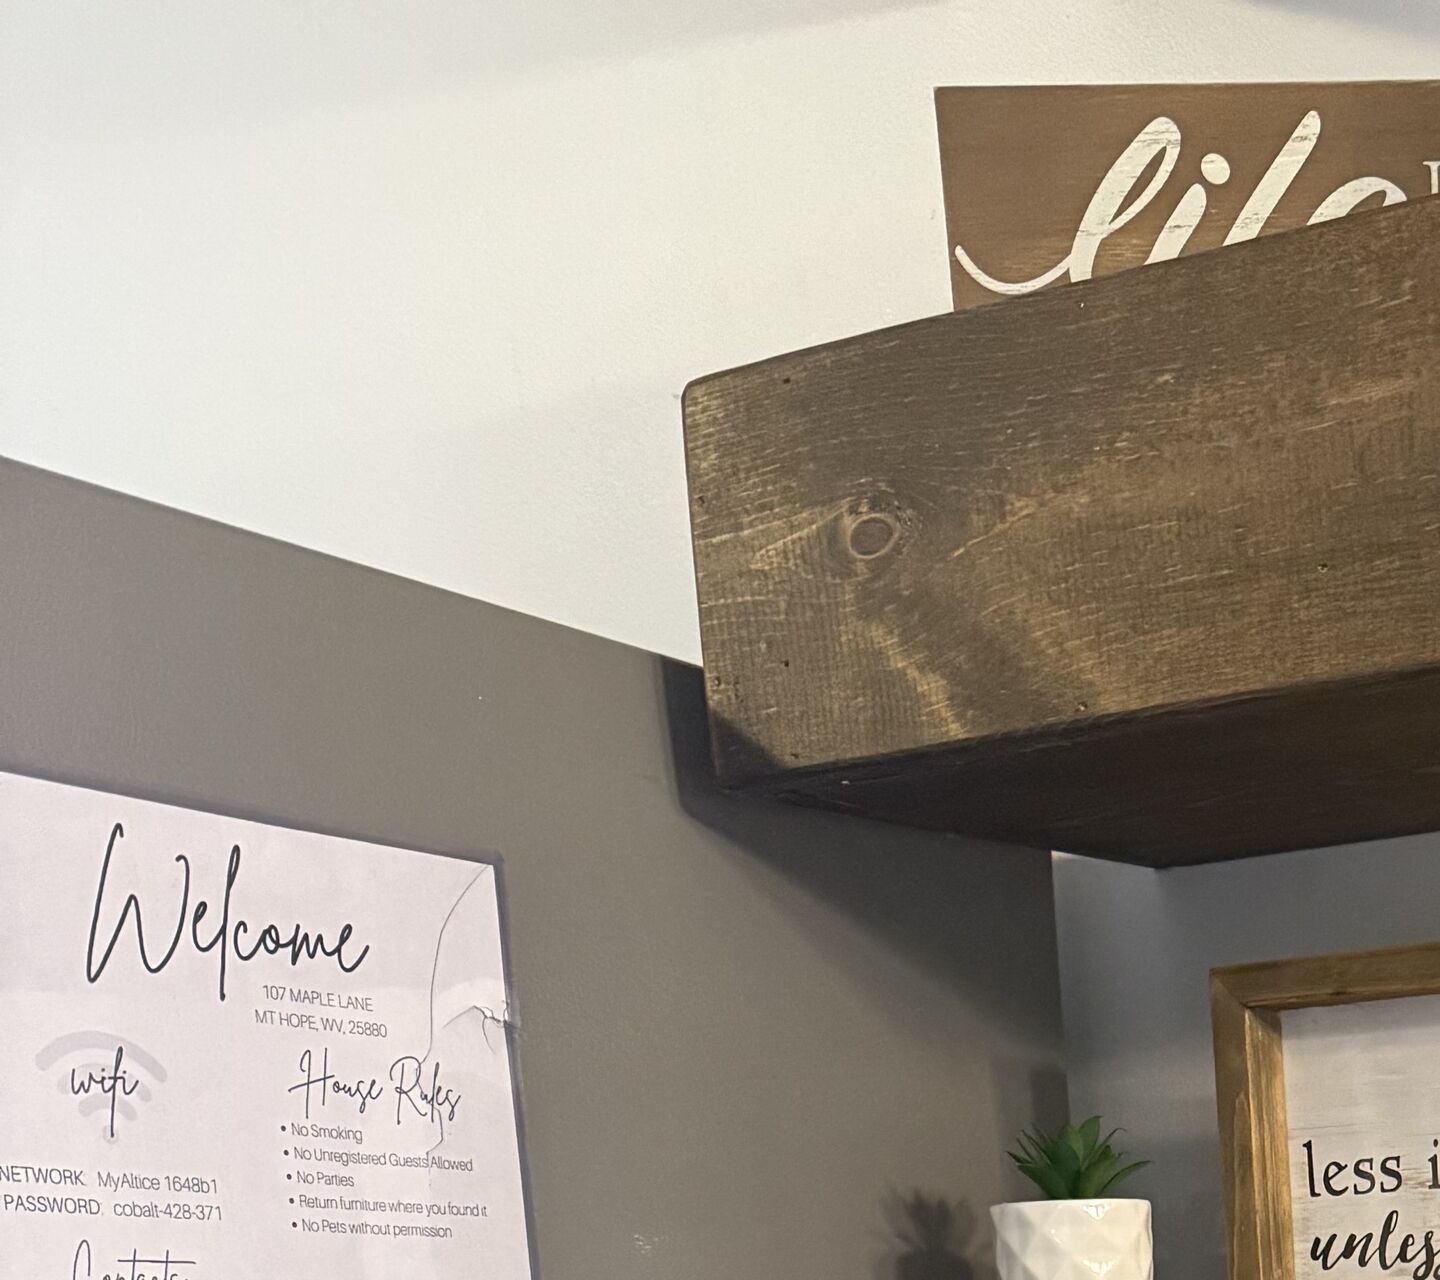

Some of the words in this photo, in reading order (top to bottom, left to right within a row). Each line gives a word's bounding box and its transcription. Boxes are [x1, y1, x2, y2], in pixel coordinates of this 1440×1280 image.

[86, 822, 370, 1001] Welcome
[263, 985, 285, 1000] 107
[290, 988, 334, 1007] MAPLE
[338, 995, 373, 1011] LANE
[255, 1009, 276, 1025] MT
[279, 1012, 318, 1032] HOPE,
[349, 1020, 387, 1038] 25880
[70, 1046, 139, 1137] wifi
[288, 1047, 383, 1119] House
[389, 1056, 462, 1124] Rules
[291, 1122, 309, 1136] No
[311, 1124, 363, 1144] Smoking
[294, 1146, 312, 1160] No
[314, 1148, 386, 1166] Unregistered
[389, 1153, 429, 1168] Guests
[431, 1156, 473, 1171] Allowed
[1302, 1139, 1403, 1198] less
[98, 1171, 160, 1192] MyAltice
[164, 1175, 218, 1194] 1648b1
[297, 1170, 314, 1184] No
[316, 1171, 354, 1187] Parties
[113, 1201, 222, 1221] cobalt-428-371
[299, 1194, 338, 1209] Return
[339, 1196, 387, 1212] furniture
[388, 1200, 423, 1214] where
[425, 1203, 446, 1217] you
[447, 1201, 480, 1217] found
[481, 1206, 488, 1216] it
[302, 1218, 319, 1233] No
[322, 1219, 347, 1234] Pets
[348, 1222, 391, 1236] without
[393, 1225, 452, 1242] permission
